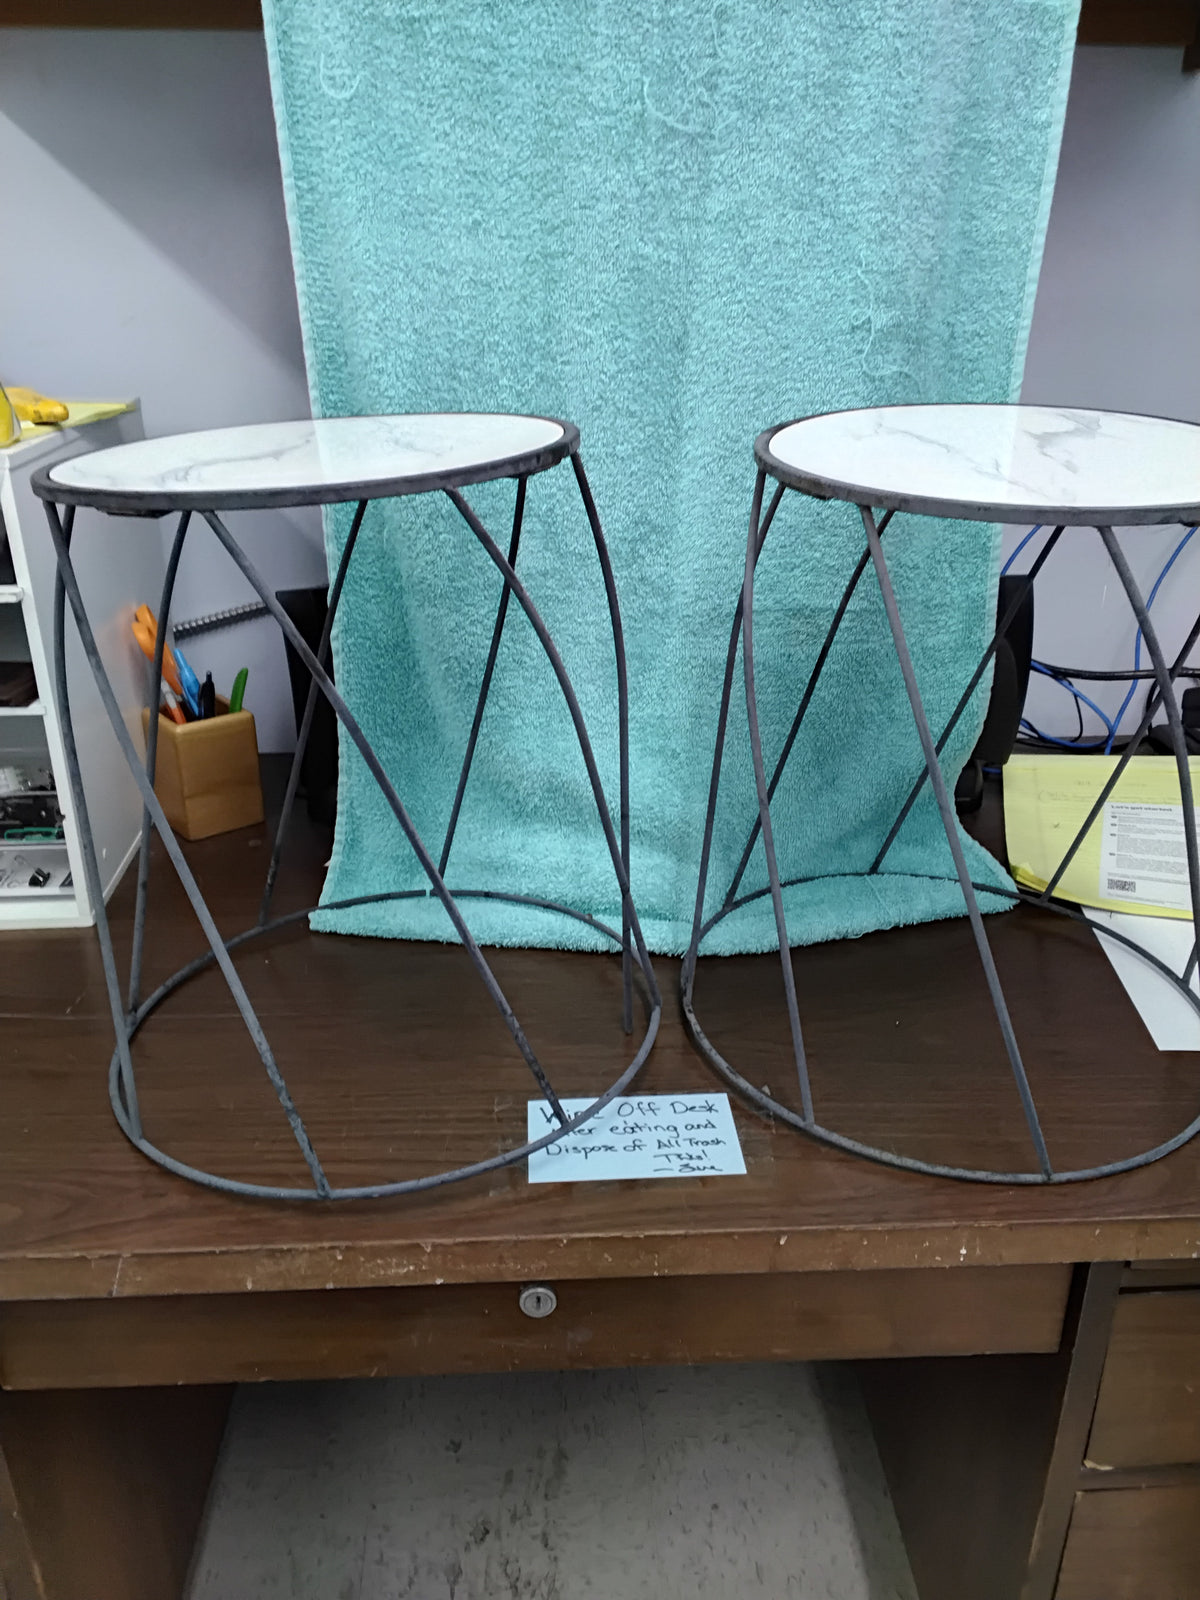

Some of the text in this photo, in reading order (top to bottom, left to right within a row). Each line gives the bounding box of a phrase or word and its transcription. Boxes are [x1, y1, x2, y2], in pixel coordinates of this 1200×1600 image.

[617, 1101, 661, 1117] Off
[669, 1099, 719, 1115] Desk
[609, 1119, 681, 1139] eating
[684, 1119, 718, 1131] and
[545, 1137, 727, 1160] Dispose of All Trash
